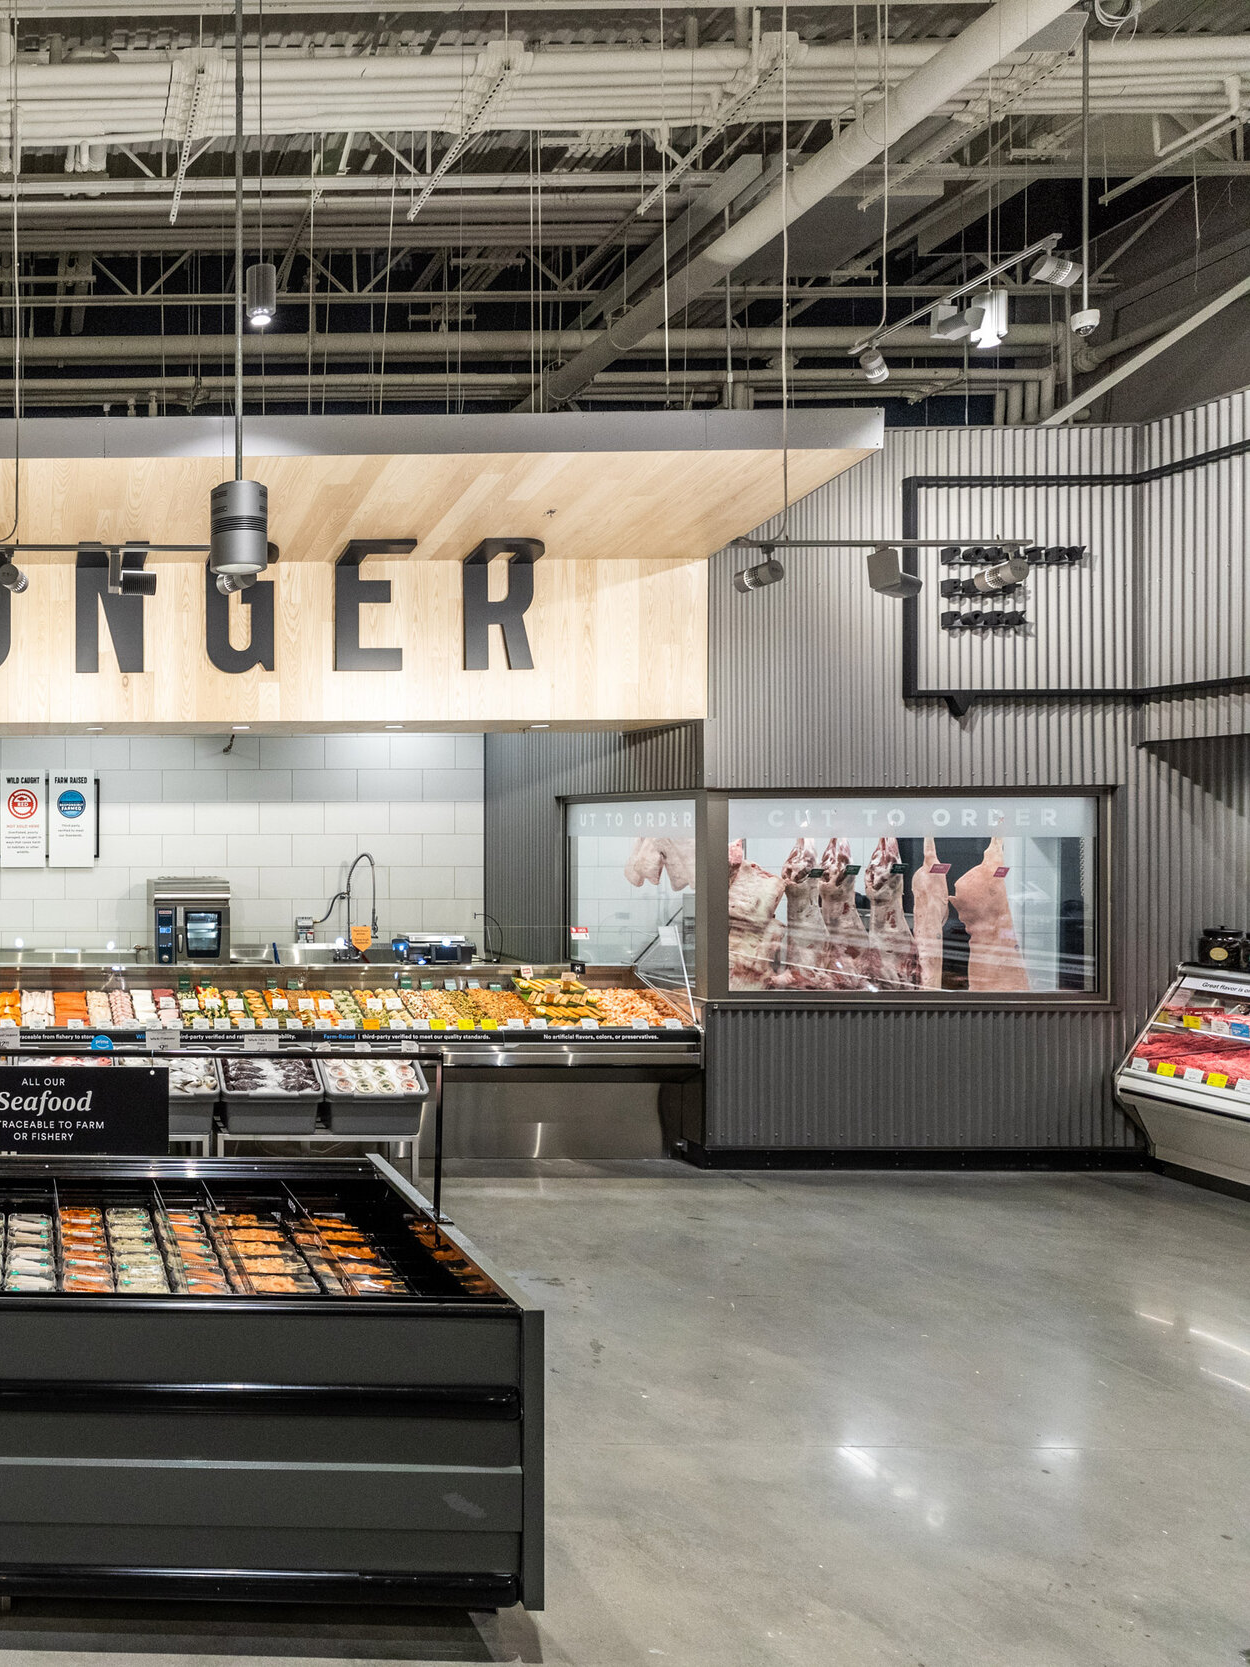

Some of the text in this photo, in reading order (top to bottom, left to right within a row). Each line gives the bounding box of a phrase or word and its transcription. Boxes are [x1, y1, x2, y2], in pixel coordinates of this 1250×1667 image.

[606, 812, 623, 827] TO
[634, 812, 692, 827] ORDER
[768, 808, 1057, 828] CUT TO ORDER
[22, 1078, 65, 1086] ALL OUR
[59, 1121, 73, 1129] TO
[76, 1121, 105, 1129] FARM
[13, 1132, 74, 1141] OR FISHERY
